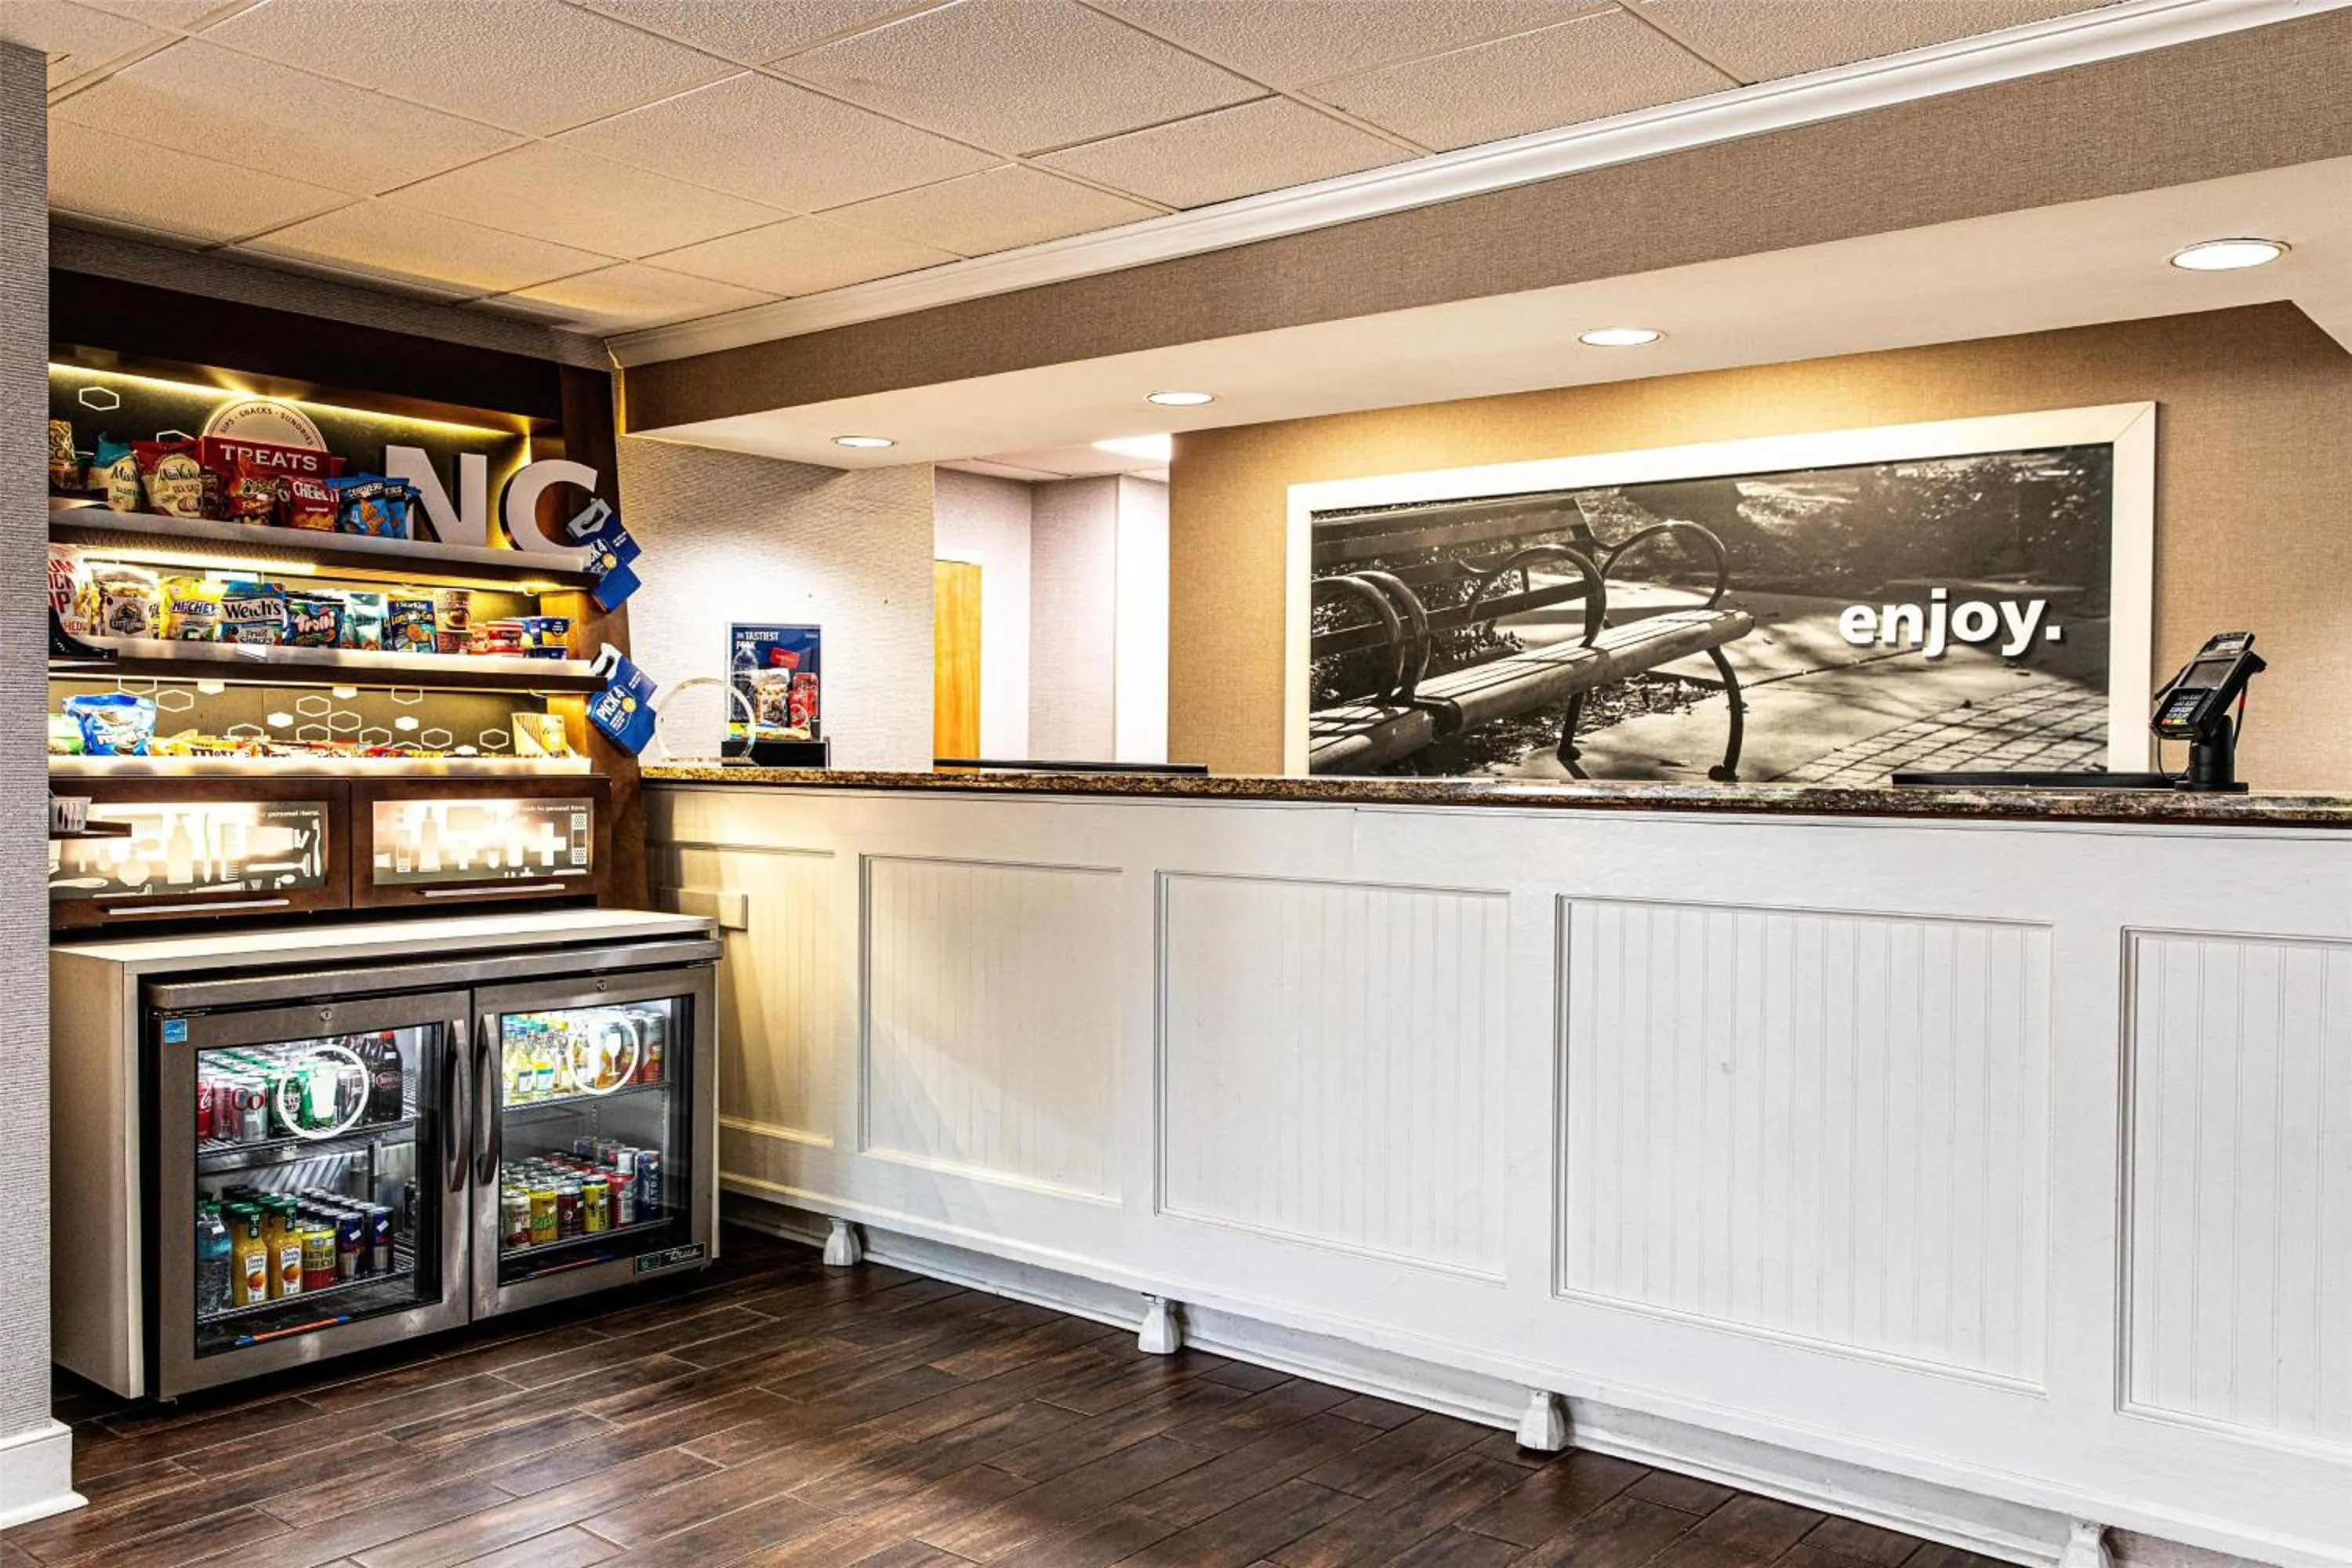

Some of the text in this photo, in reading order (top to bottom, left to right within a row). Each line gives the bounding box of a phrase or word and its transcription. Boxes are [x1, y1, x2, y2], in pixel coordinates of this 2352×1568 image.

[238, 407, 272, 417] SNACKS
[280, 412, 314, 446] SUNDRIES
[220, 444, 318, 471] TREATS
[745, 631, 779, 641] TASTIEST
[1838, 587, 2062, 659] enjoy.
[596, 691, 622, 722] PICK
